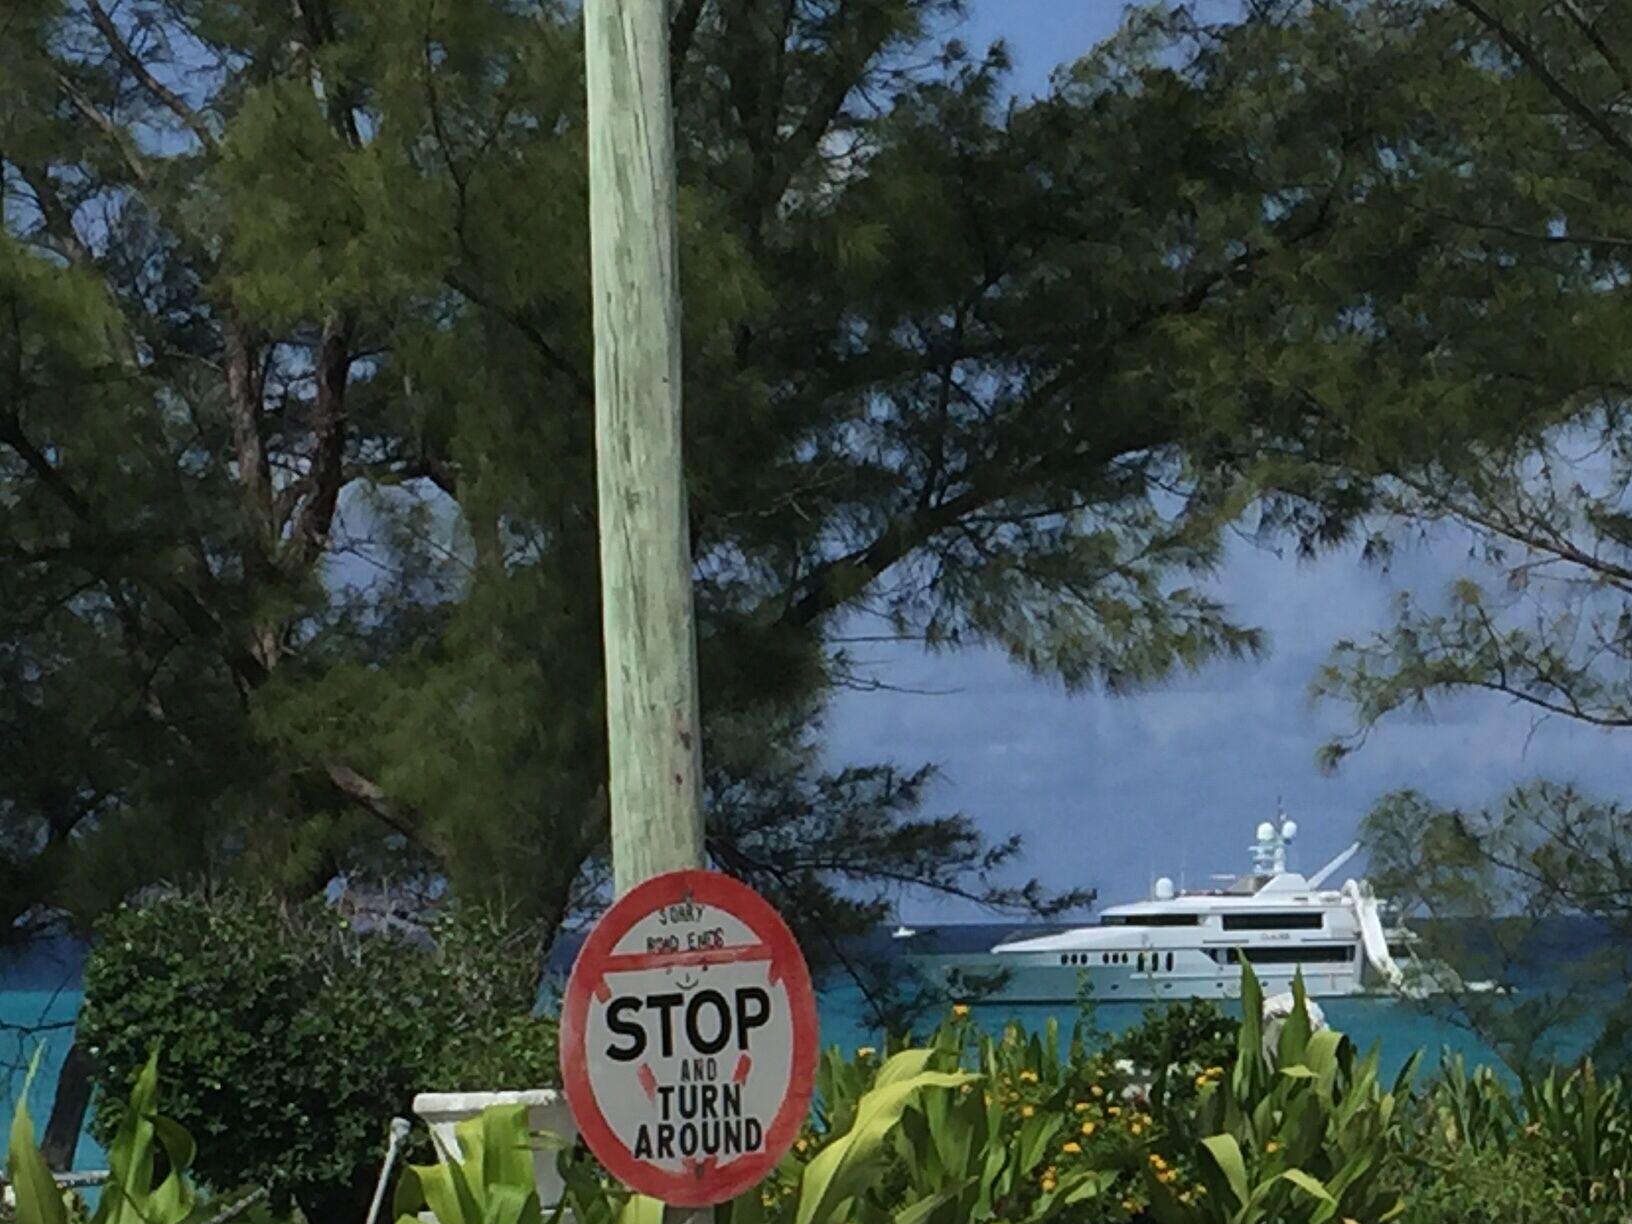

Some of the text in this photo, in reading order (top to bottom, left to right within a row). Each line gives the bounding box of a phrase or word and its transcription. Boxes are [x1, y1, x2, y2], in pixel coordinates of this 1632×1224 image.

[605, 987, 771, 1062] STOP
[680, 1057, 718, 1082] AND
[657, 1083, 742, 1121] TURN
[634, 1117, 763, 1160] AROUND
